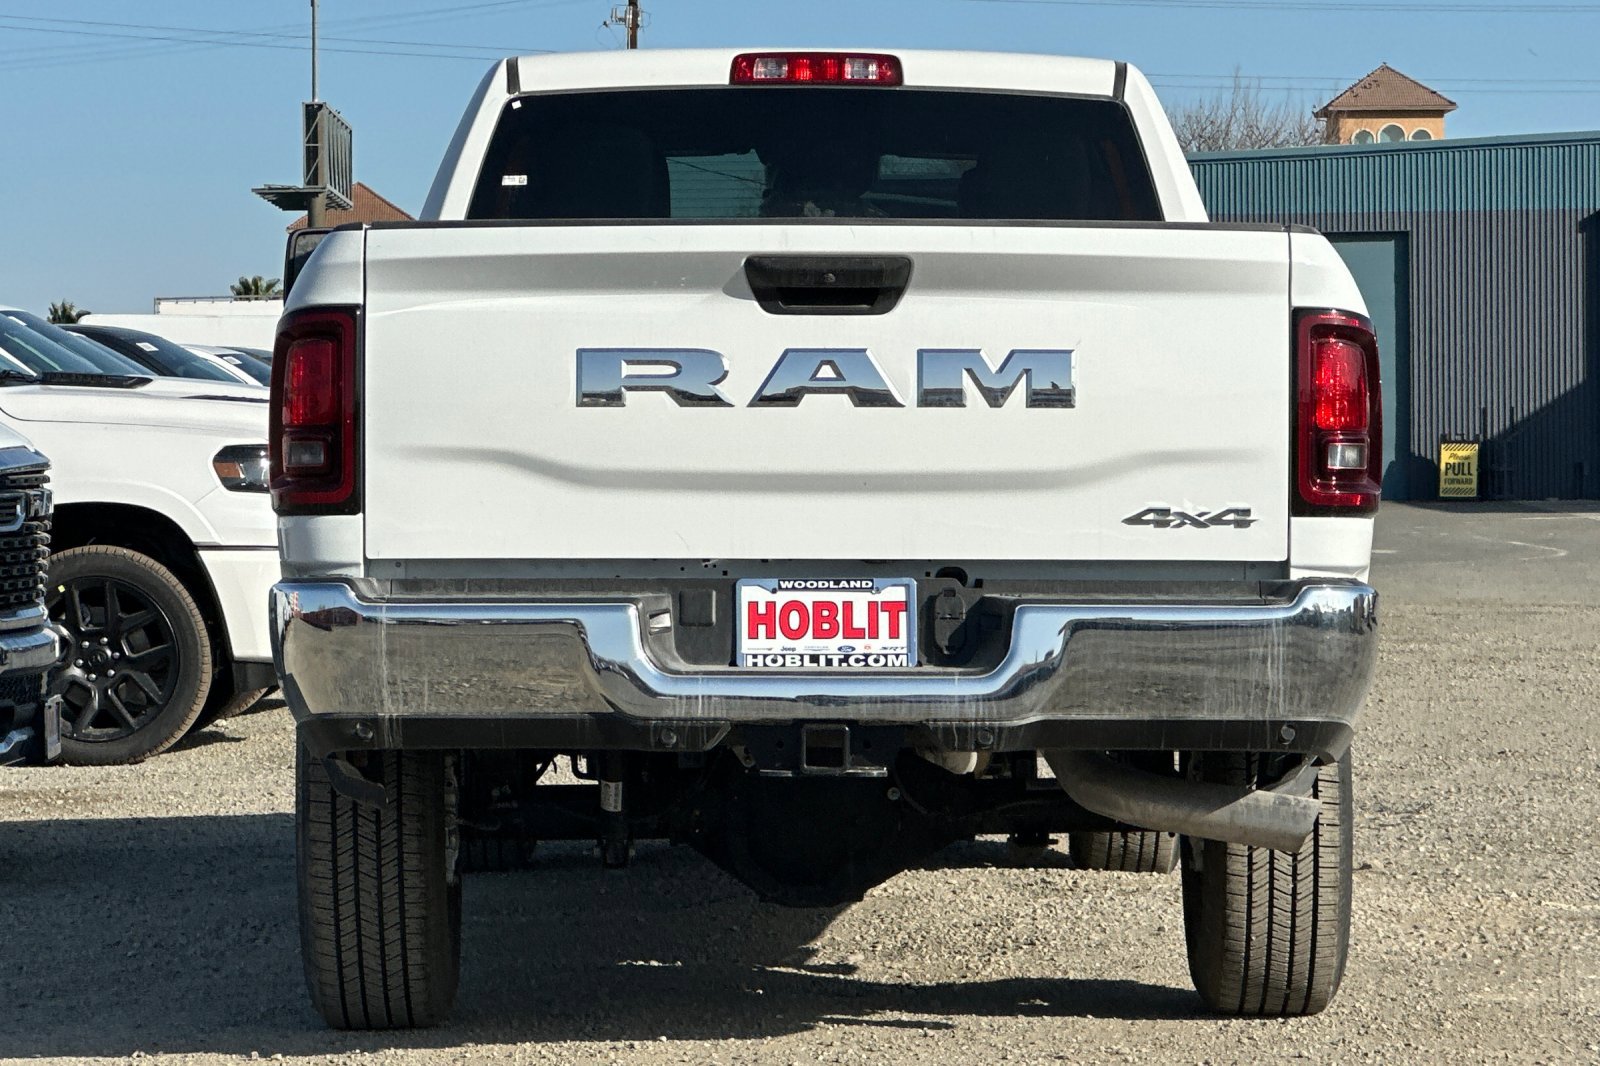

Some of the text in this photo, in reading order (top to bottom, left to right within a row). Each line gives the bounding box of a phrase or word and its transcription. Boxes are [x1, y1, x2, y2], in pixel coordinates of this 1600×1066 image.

[576, 348, 1075, 408] RAM
[1445, 462, 1473, 476] PULL
[779, 580, 872, 588] WOODLAND
[748, 600, 907, 640] HOBLIT
[746, 654, 908, 667] HOBLIT.COM
